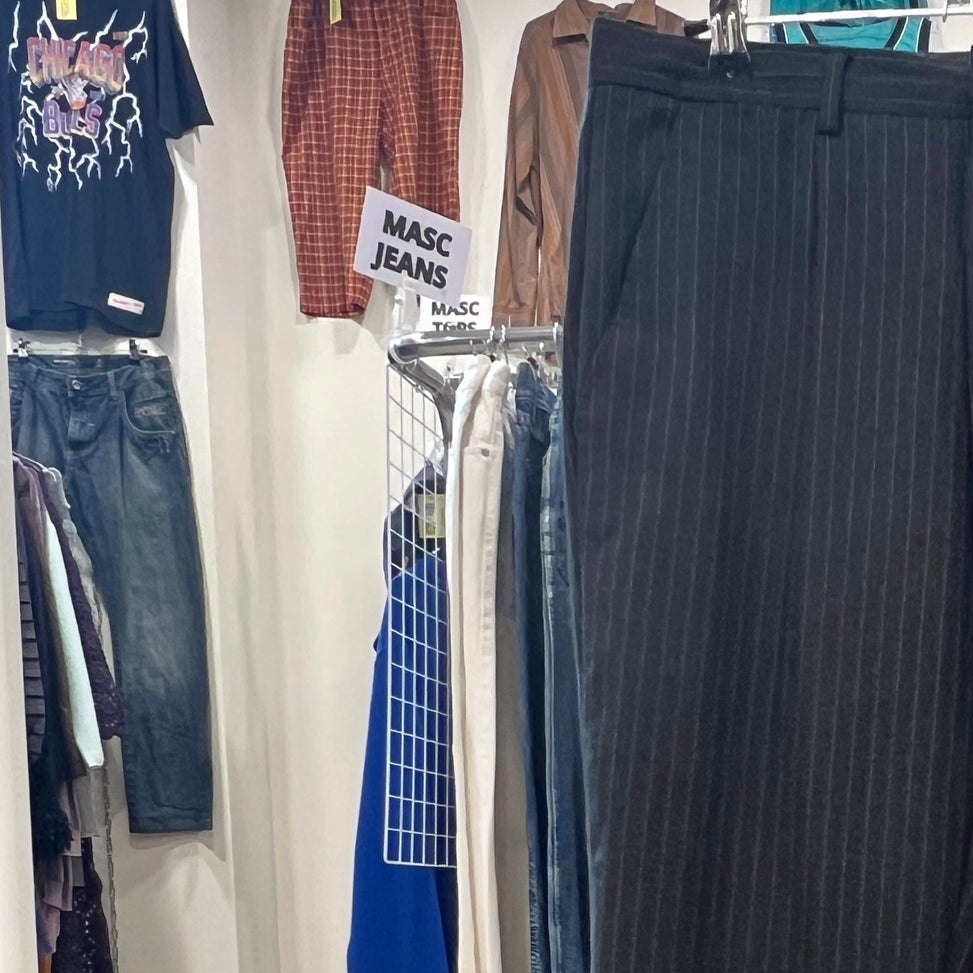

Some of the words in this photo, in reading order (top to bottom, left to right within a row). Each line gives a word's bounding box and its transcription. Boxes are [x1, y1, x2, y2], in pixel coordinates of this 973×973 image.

[382, 209, 453, 257] MASC
[370, 241, 449, 289] JEANS
[431, 301, 480, 316] MASC
